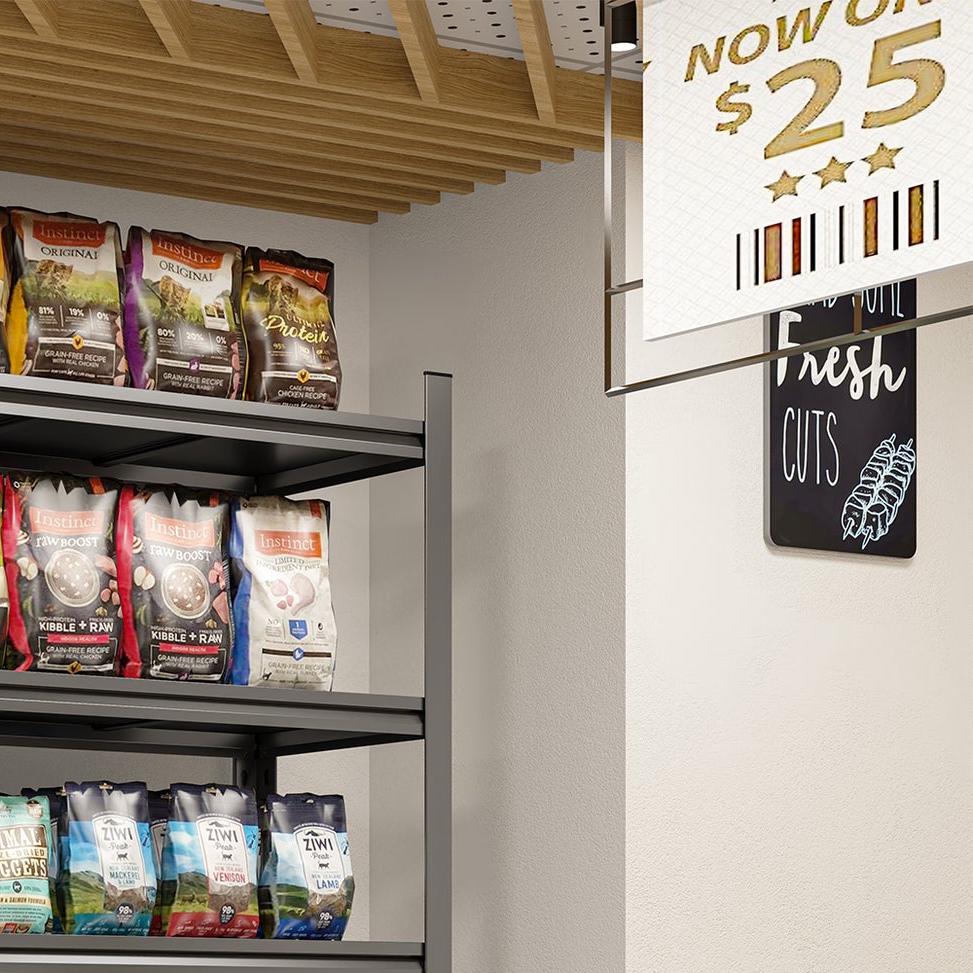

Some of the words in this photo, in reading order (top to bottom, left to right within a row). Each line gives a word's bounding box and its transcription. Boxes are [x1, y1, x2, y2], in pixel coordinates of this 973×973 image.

[684, 2, 828, 82] NOW
[715, 19, 946, 160] $25
[39, 224, 101, 241] Instinct
[38, 306, 55, 315] 81%
[68, 307, 85, 317] 19%
[96, 311, 110, 321] 0%
[157, 327, 176, 338] 80%
[259, 314, 330, 344] Protein
[215, 335, 227, 345] 0%
[44, 349, 84, 361] GRAIN-FREE
[84, 354, 107, 364] RECIPE
[777, 309, 908, 401] Fresh
[162, 371, 202, 385] GRAIN-FREE
[201, 377, 224, 388] RECIPE
[781, 406, 840, 487] CUTS
[34, 511, 98, 528] Instinct
[150, 516, 209, 540] Instinct
[259, 534, 316, 551] Instinct
[39, 622, 76, 633] KIBBLE
[89, 622, 114, 633] RAW
[151, 631, 187, 643] KIBBLE
[198, 633, 223, 644] RAW
[45, 646, 85, 655] GRAIN-FREE
[85, 646, 110, 655] RECIPE
[157, 654, 195, 665] GRAIN-FREE
[195, 656, 219, 665] RECIPE
[101, 826, 134, 842] ZIWI
[207, 826, 239, 842] ZIWI
[302, 838, 334, 852] ZIWI
[109, 870, 141, 880] MACKEREL
[213, 871, 246, 884] VENISON
[315, 879, 340, 891] LAMB
